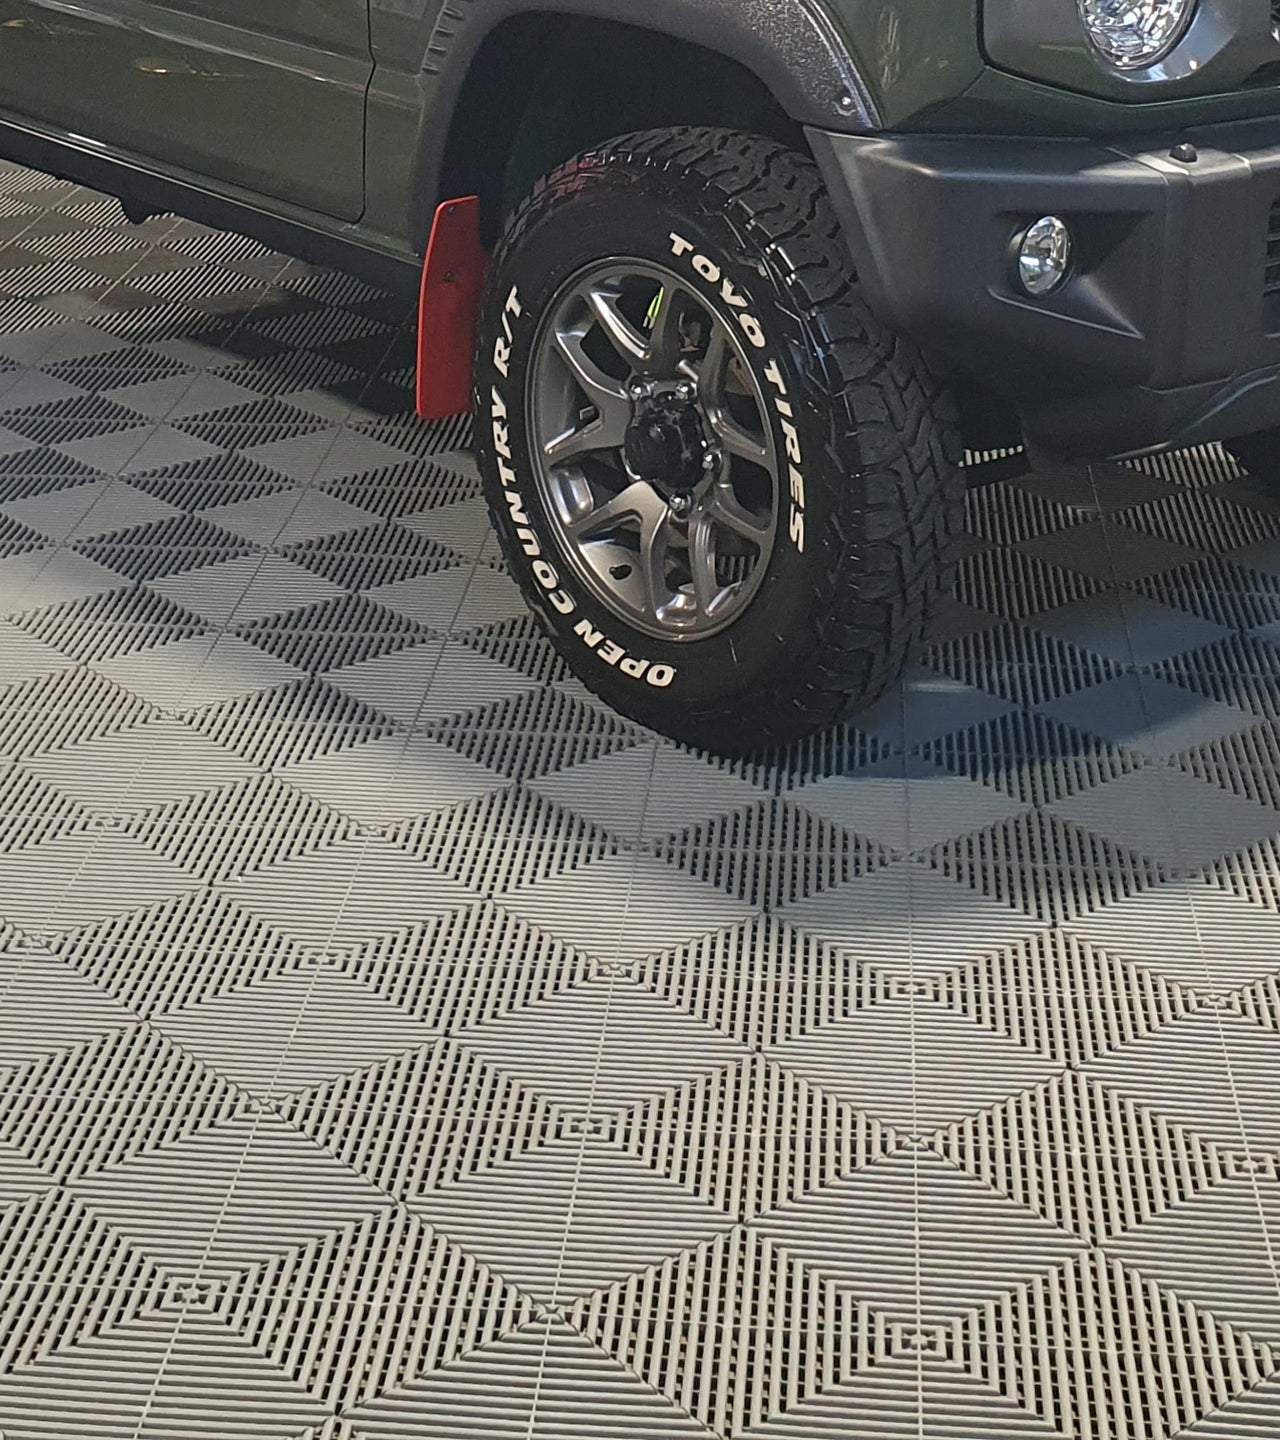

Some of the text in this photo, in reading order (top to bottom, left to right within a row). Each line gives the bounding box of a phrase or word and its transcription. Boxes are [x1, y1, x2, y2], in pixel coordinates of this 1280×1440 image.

[491, 284, 676, 687] OPEN COUNTRY R/T
[670, 232, 805, 553] TOYO TIRES
